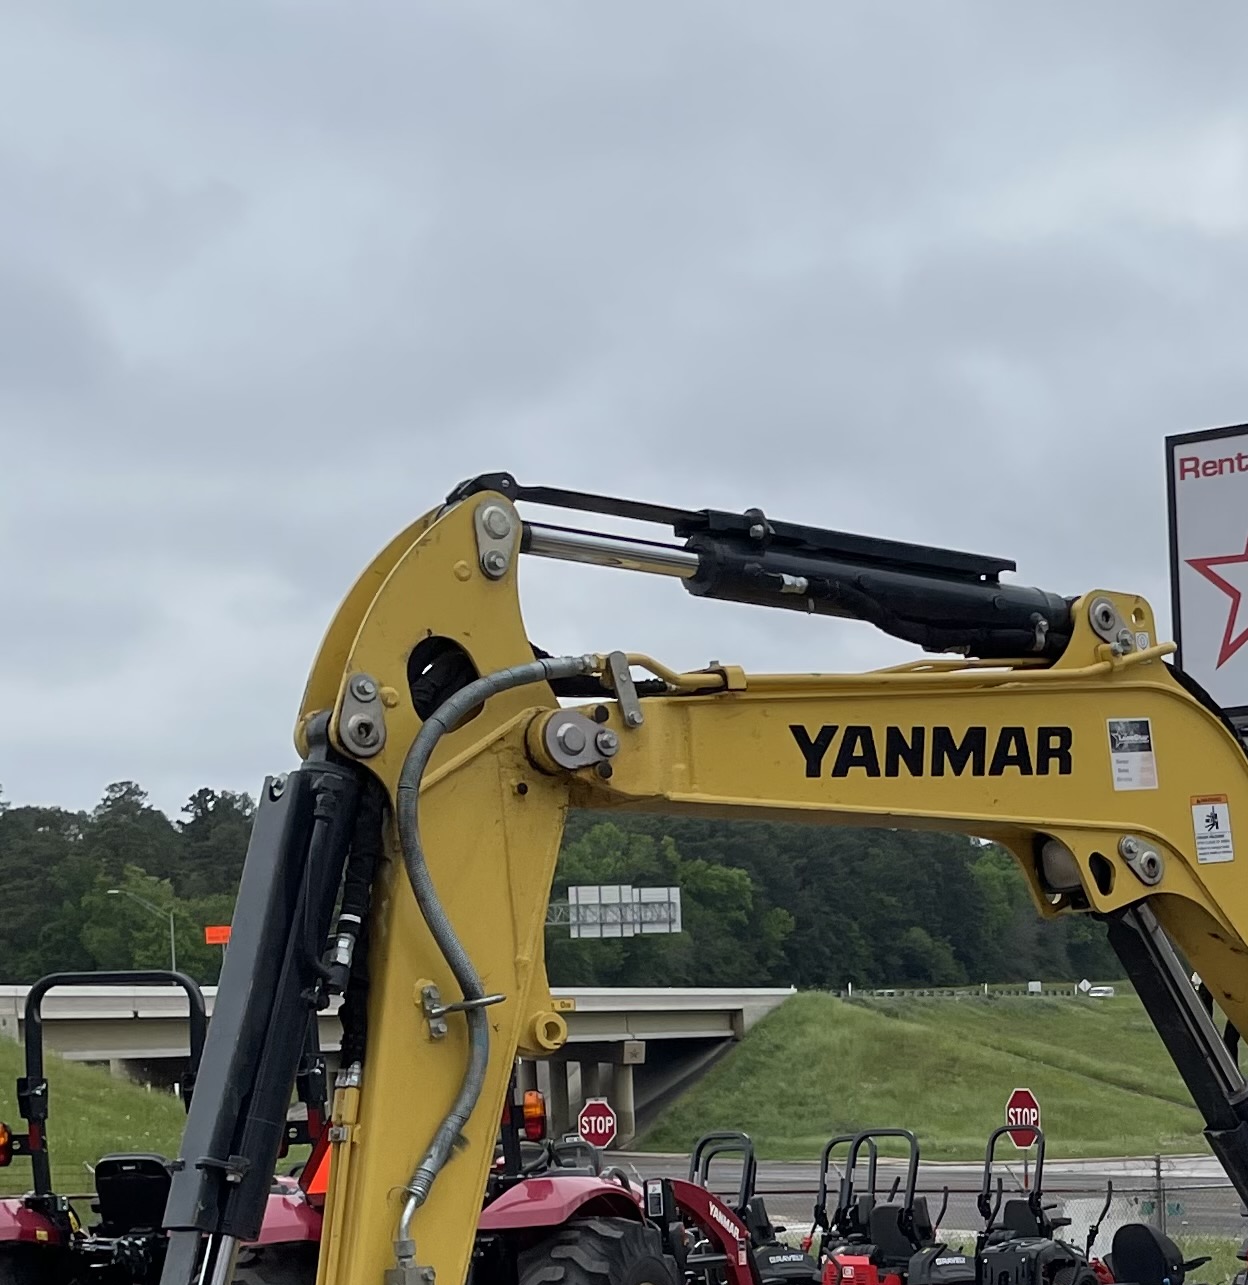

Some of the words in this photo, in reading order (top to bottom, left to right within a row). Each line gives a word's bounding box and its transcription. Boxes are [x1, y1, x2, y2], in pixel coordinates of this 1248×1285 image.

[788, 725, 1073, 778] YANMAR
[581, 1116, 614, 1135] STOP
[1008, 1107, 1038, 1126] STOP
[708, 1200, 740, 1241] YANMAR
